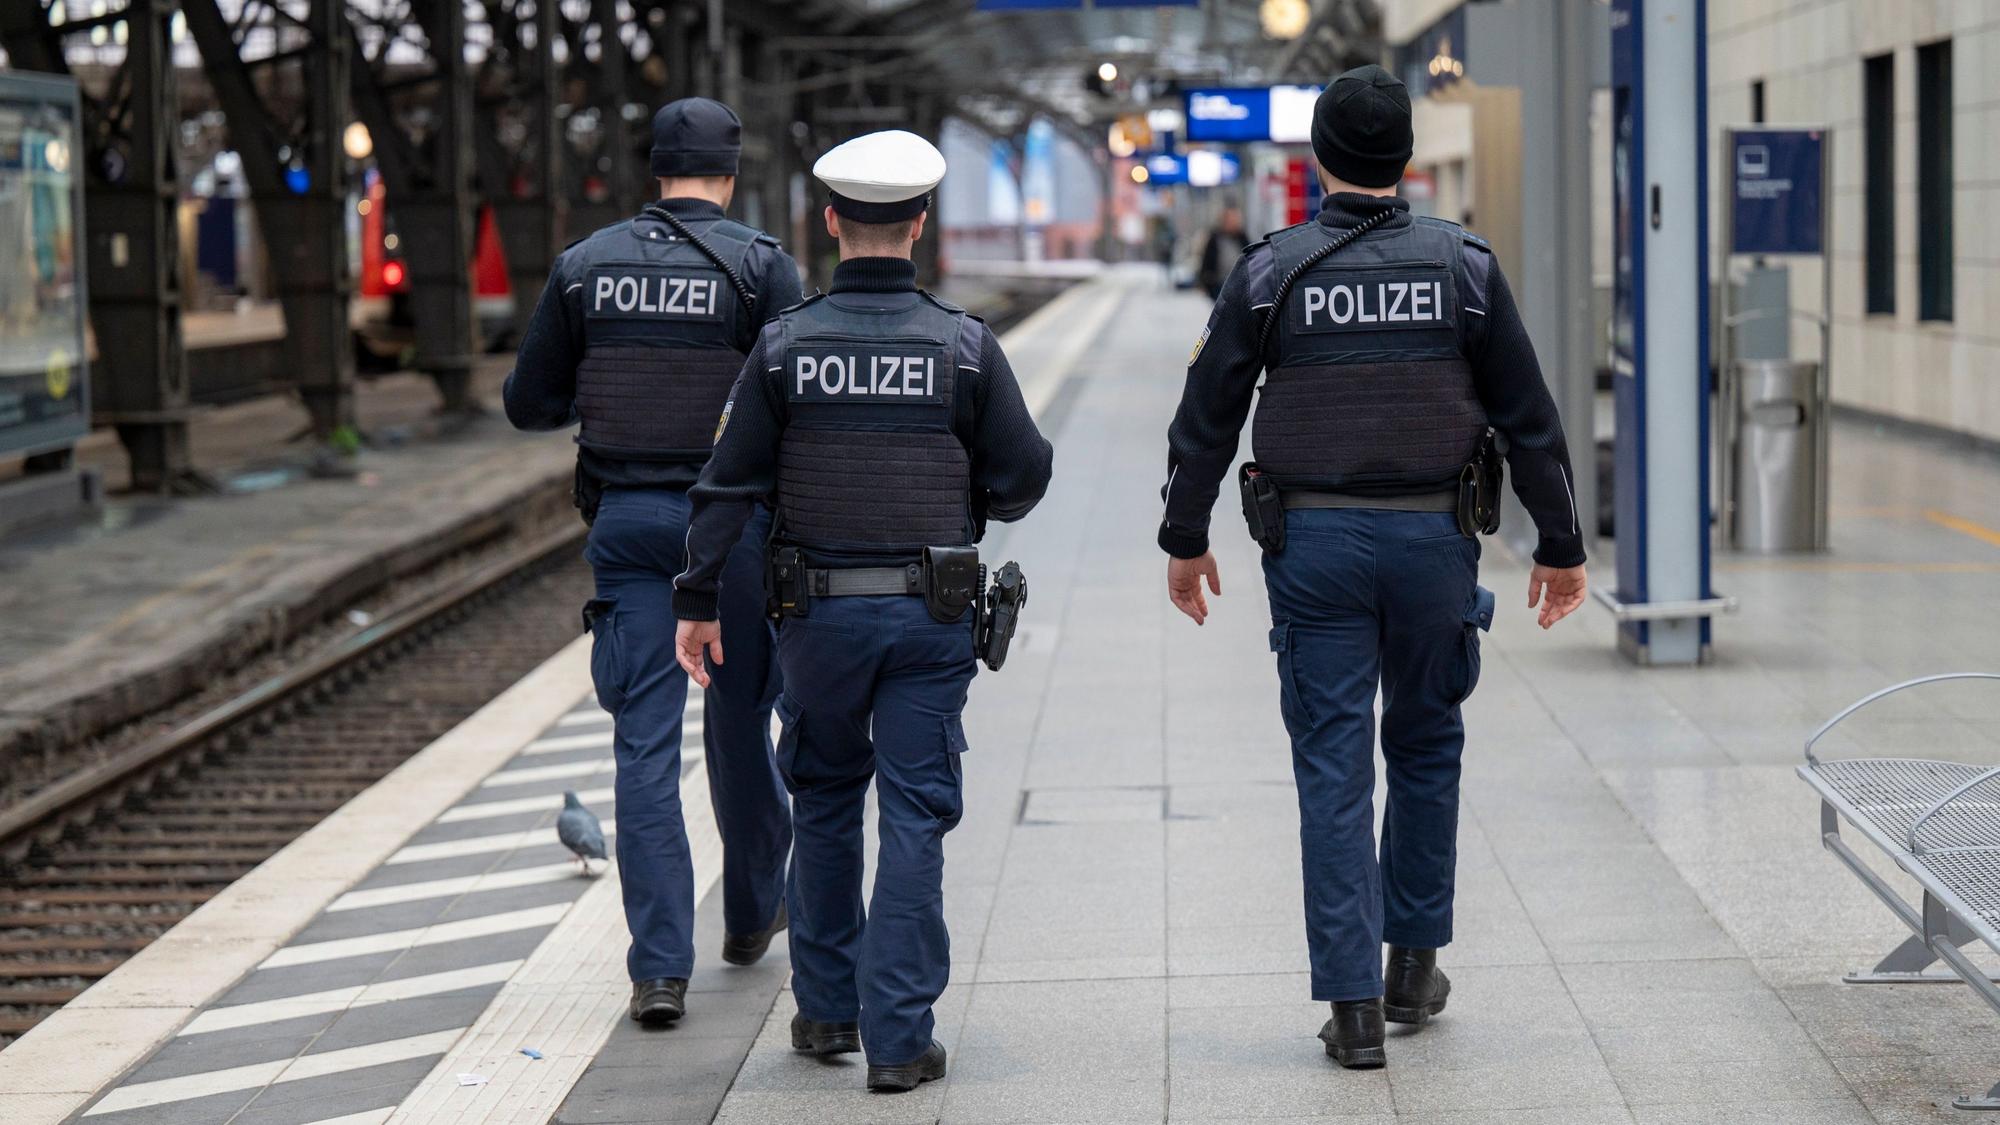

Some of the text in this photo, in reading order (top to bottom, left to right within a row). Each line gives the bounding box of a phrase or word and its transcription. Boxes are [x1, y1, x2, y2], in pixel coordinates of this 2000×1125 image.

[594, 276, 717, 315] POLIZEI
[1304, 281, 1442, 326] POLIZEI
[796, 355, 934, 396] POLIZEI
